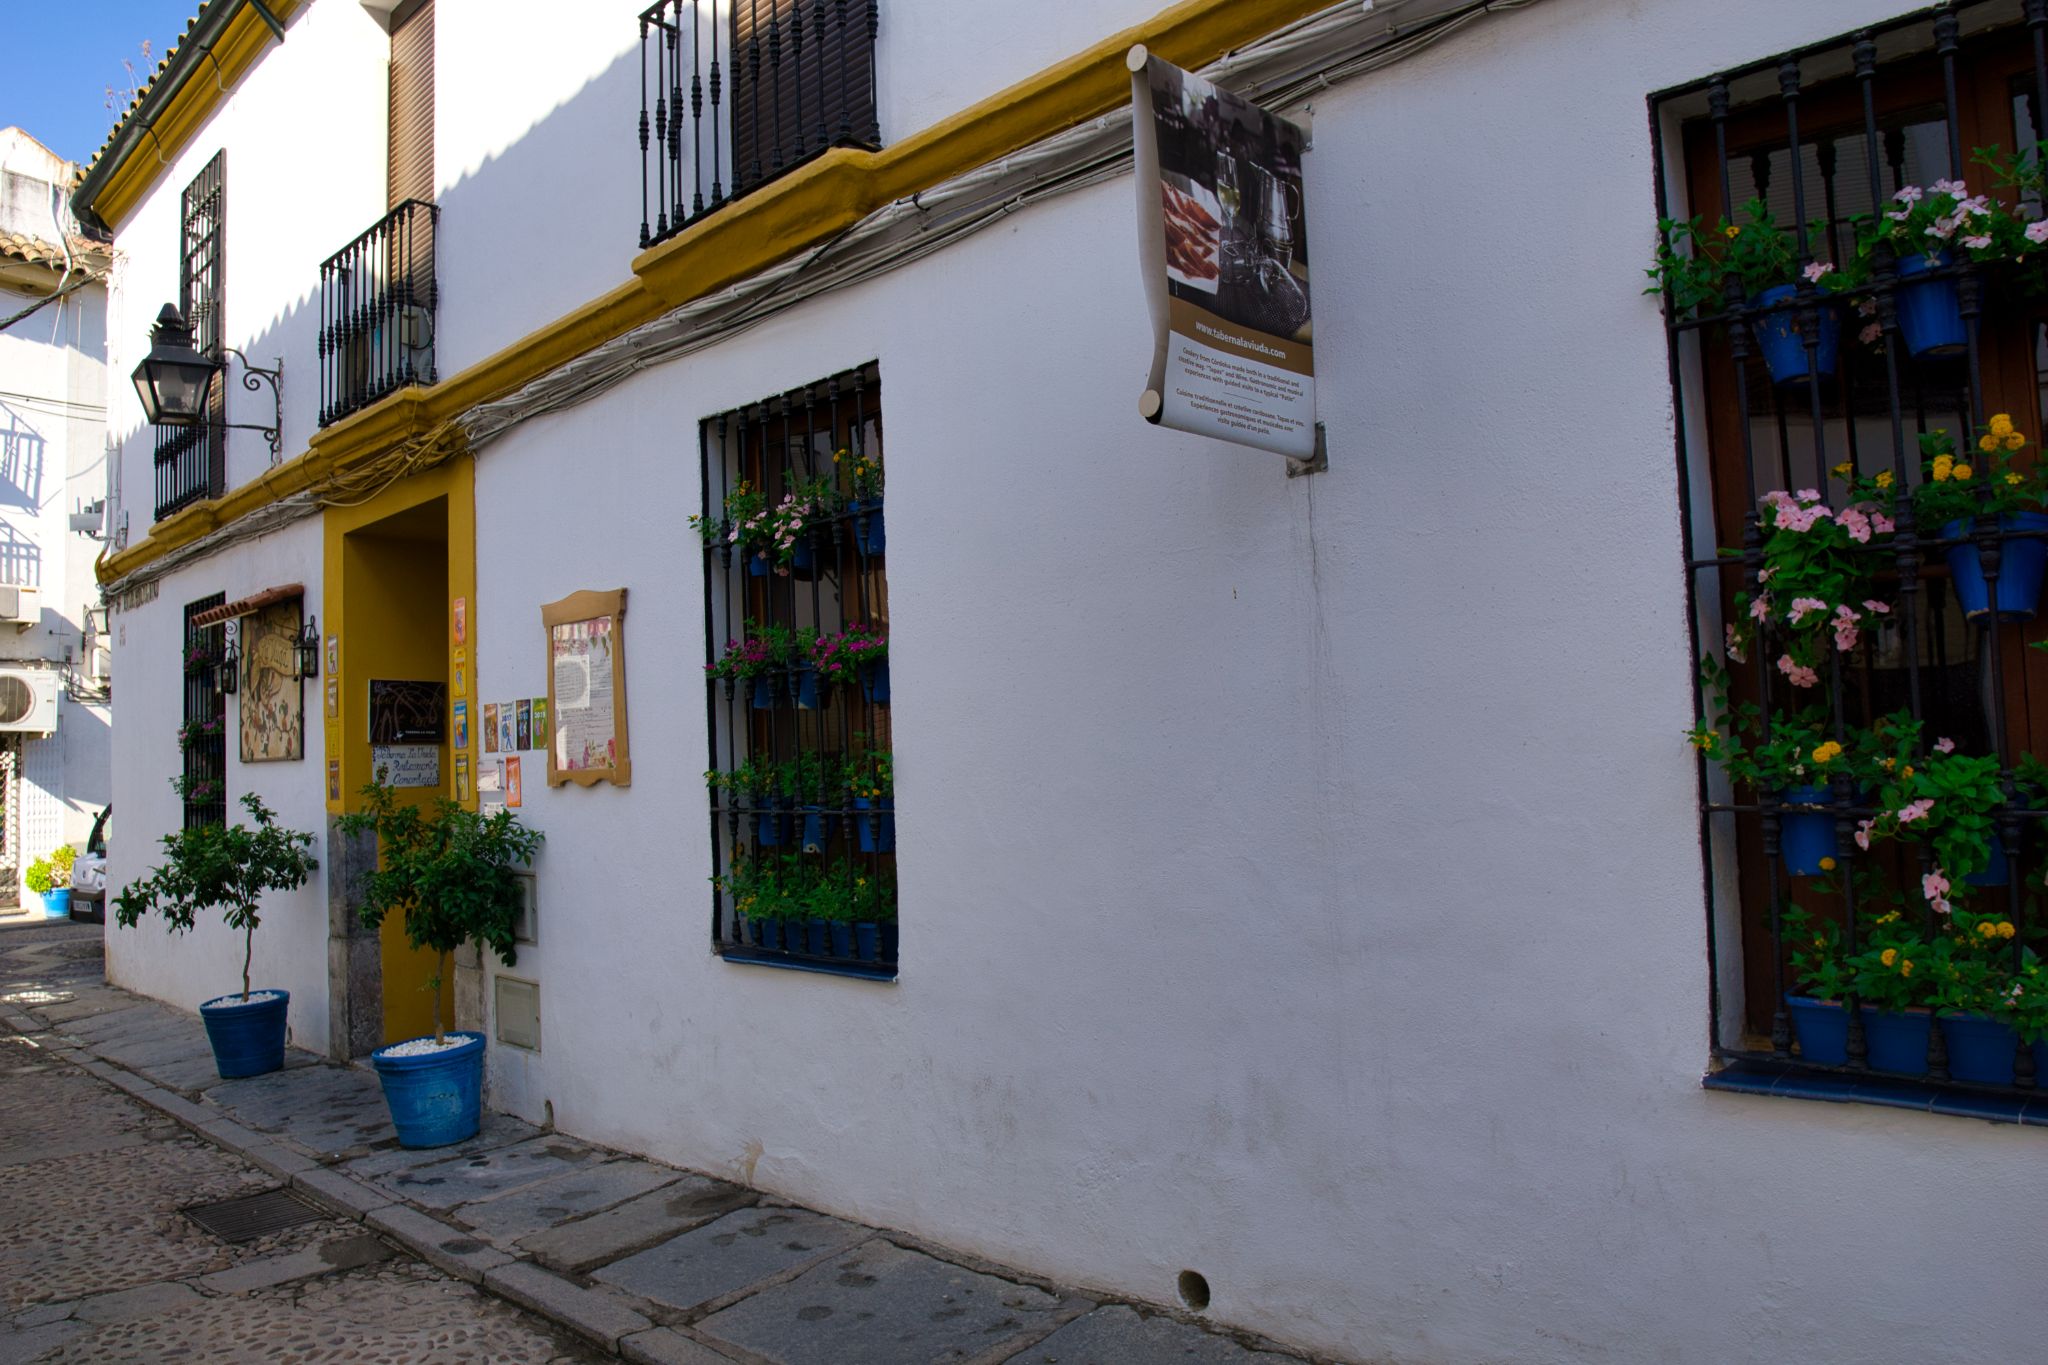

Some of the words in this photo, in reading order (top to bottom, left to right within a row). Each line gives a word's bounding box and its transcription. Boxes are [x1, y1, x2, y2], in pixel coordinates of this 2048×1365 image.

[1195, 320, 1286, 360] www.tabernalaviuda.com
[1182, 347, 1200, 360] Cookery
[1200, 353, 1211, 363] from
[1266, 374, 1290, 386] traditional
[1184, 367, 1211, 380] experiences
[1211, 375, 1223, 384] with
[1223, 379, 1241, 388] guided
[1263, 388, 1279, 398] typical
[1249, 376, 1278, 390] Gastronomic
[1277, 385, 1287, 393] and
[1286, 388, 1303, 397] musical
[1276, 414, 1290, 423] Tapas
